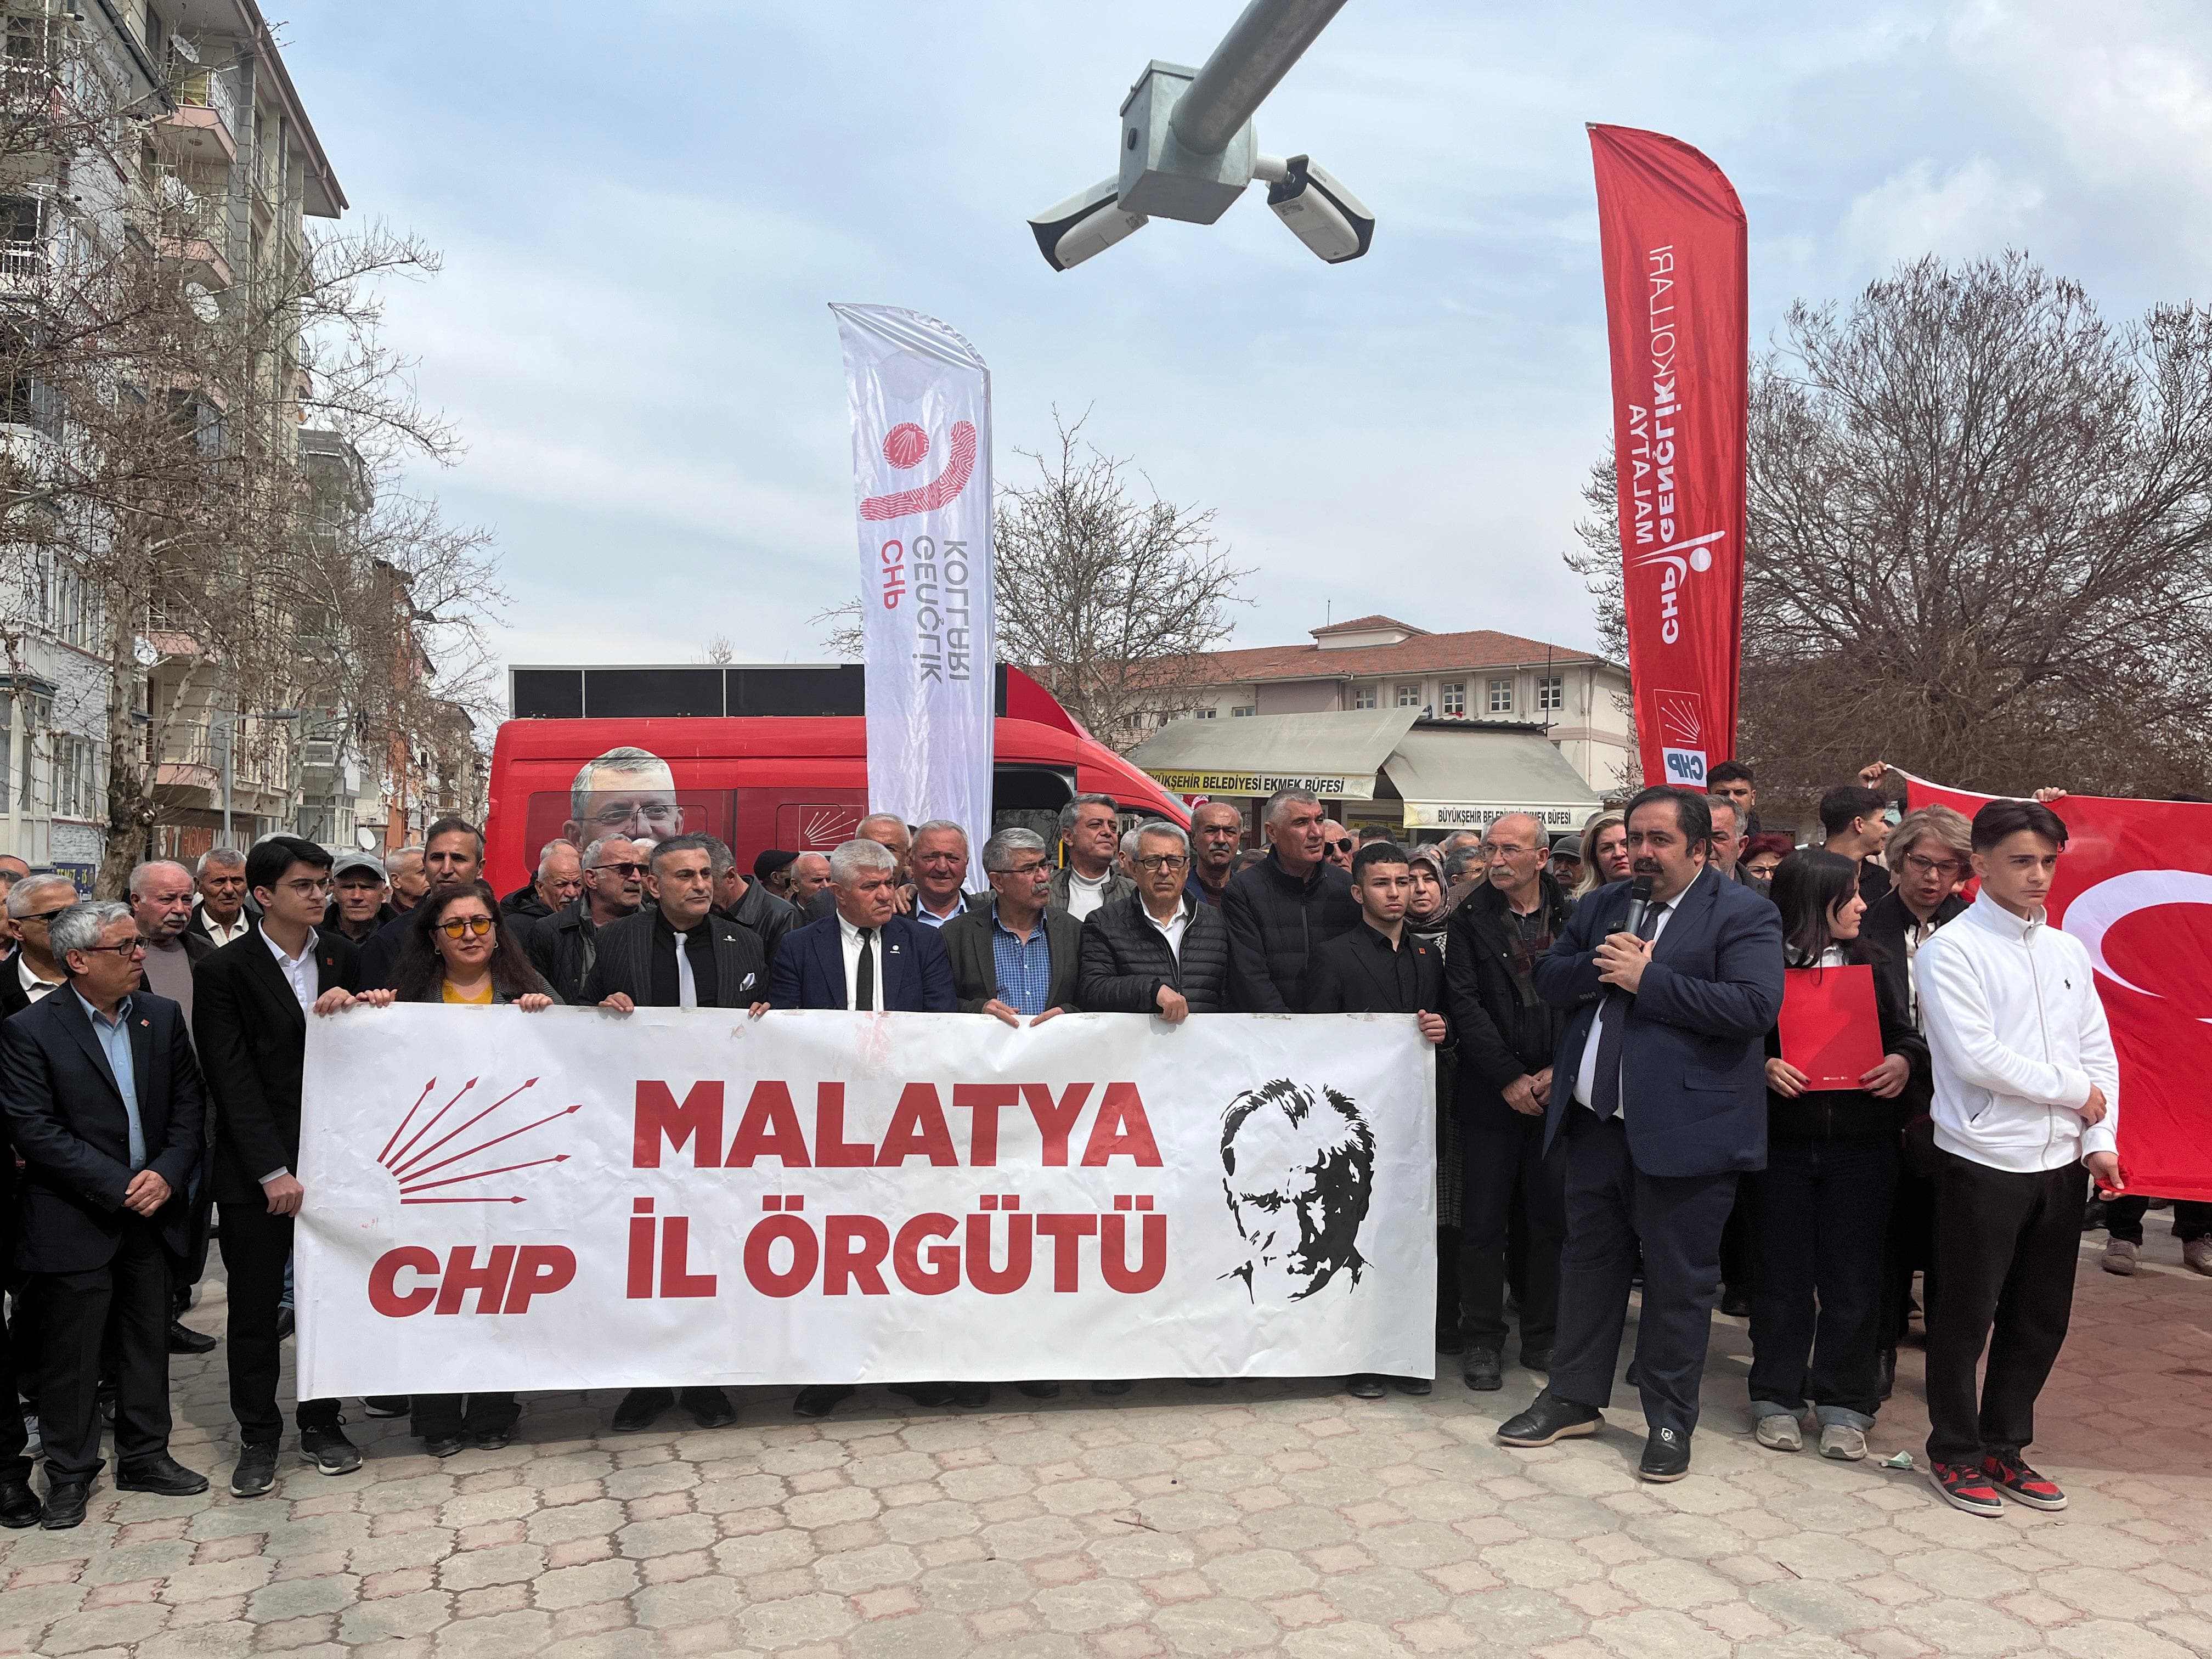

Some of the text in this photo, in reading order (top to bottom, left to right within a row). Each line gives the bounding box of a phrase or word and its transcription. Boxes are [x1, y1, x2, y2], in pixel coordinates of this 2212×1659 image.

[1203, 774, 1262, 791] BELEDİYESİ
[1305, 777, 1345, 793] BÜFESİ
[182, 826, 212, 858] HOME
[1438, 806, 1481, 826] BÜYÜKŞEHİR
[1548, 809, 1571, 825] BÜFESİ
[633, 1080, 1164, 1168] MALATYA
[627, 1195, 1167, 1299] İL ÖRGÜTÜ
[368, 1244, 577, 1318] CHP
